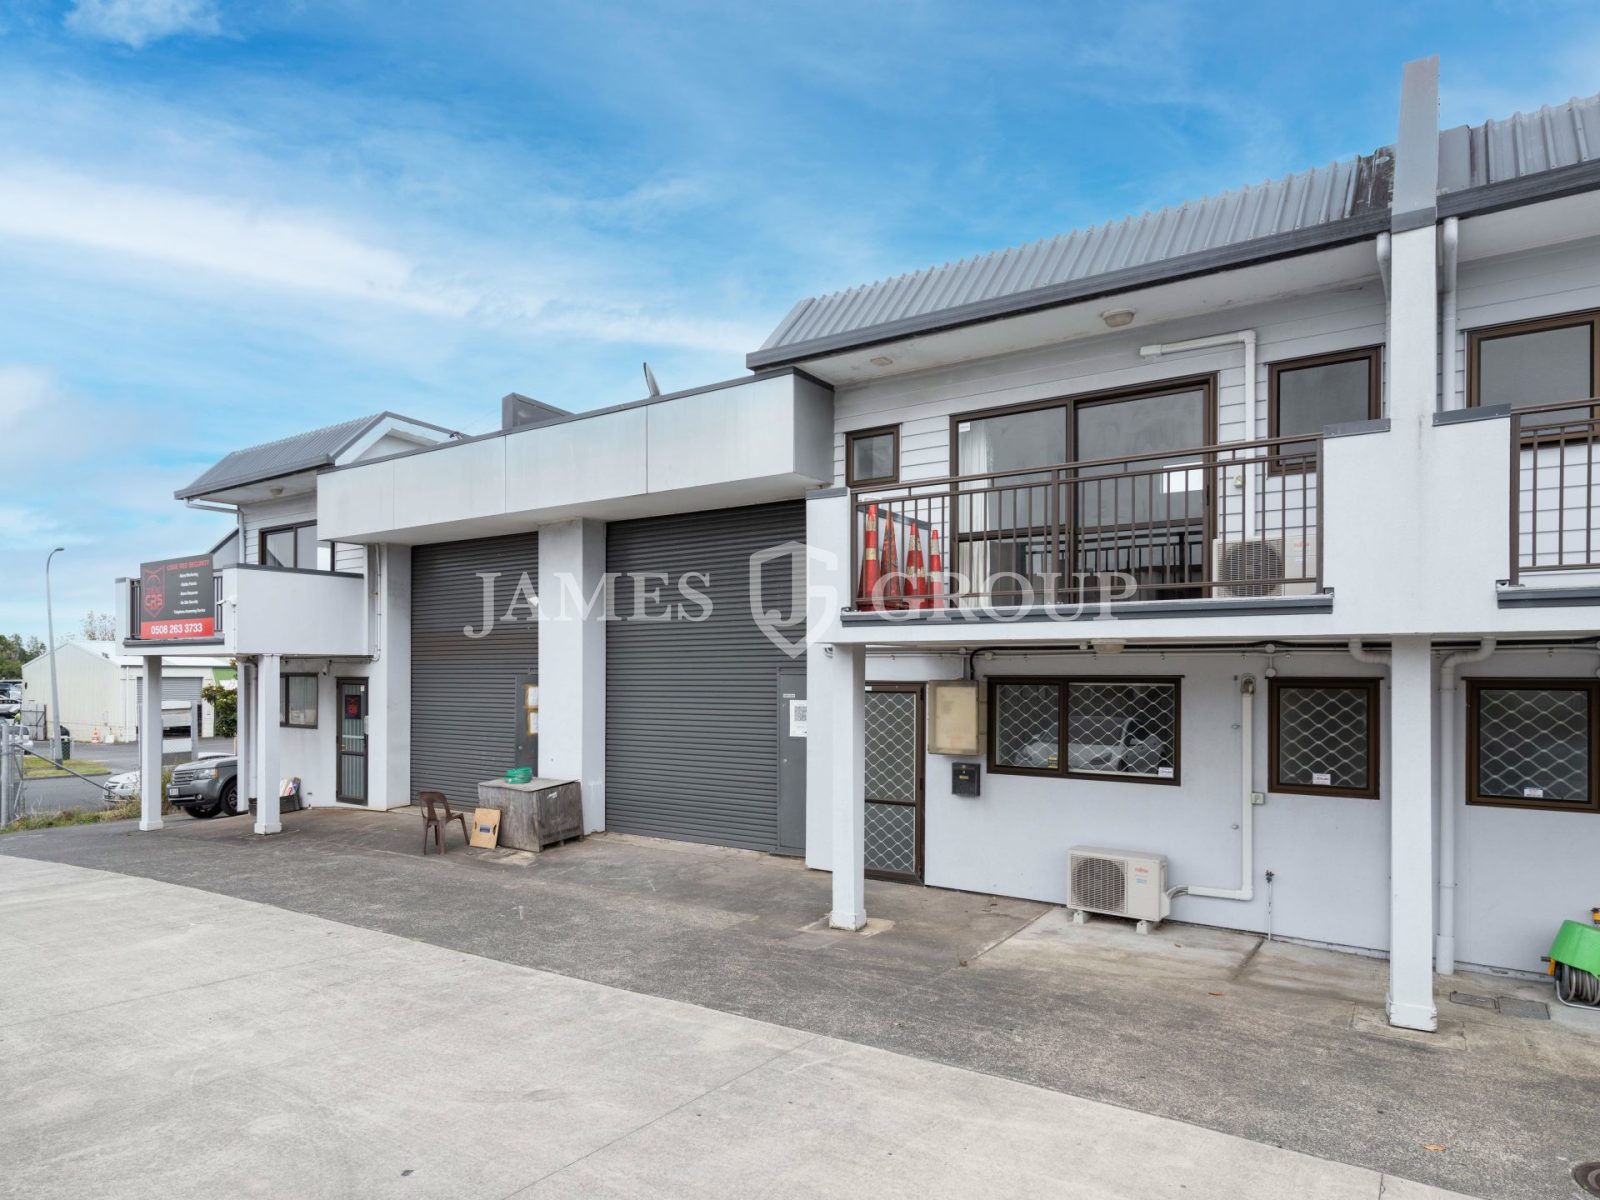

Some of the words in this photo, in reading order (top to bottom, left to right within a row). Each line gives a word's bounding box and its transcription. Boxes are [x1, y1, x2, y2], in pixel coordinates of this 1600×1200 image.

[151, 625, 168, 634] 0508
[169, 624, 183, 634] 263
[184, 623, 203, 633] 3733
